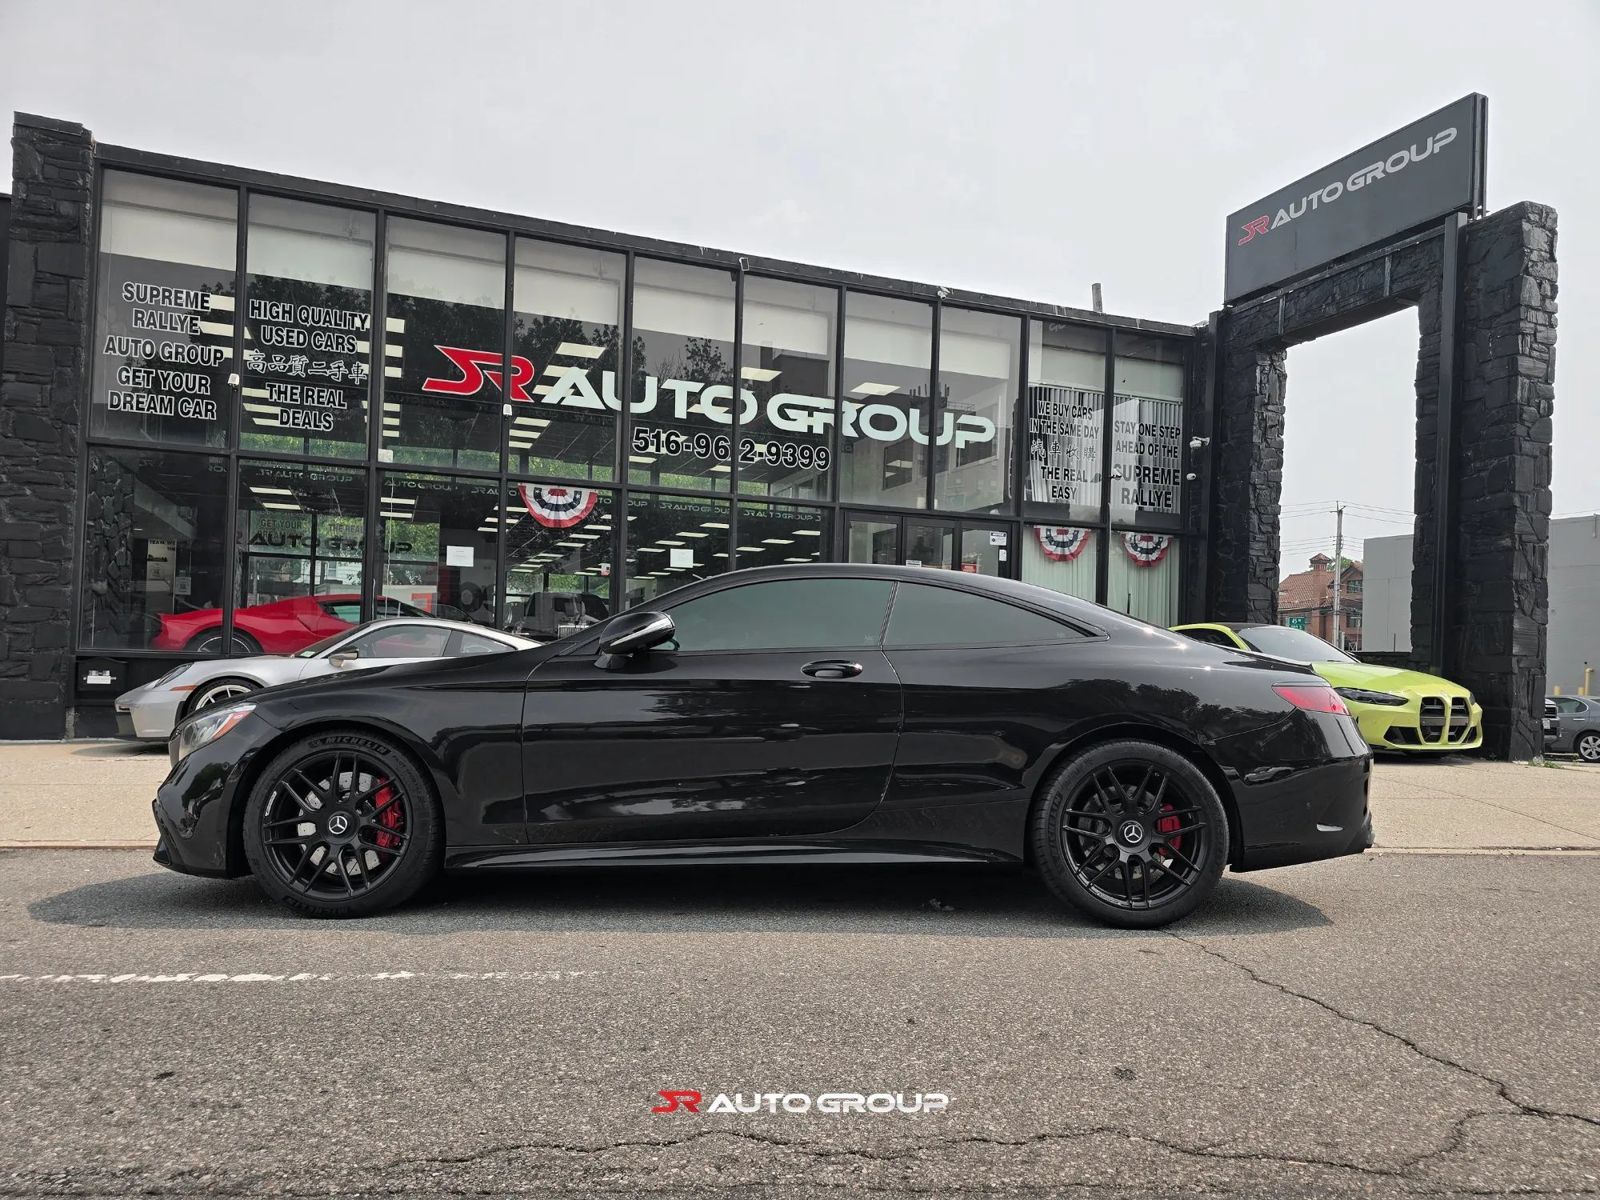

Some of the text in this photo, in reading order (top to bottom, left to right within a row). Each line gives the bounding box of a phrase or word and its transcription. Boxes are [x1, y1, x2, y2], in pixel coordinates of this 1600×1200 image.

[1270, 182, 1343, 230] AUTO
[1346, 127, 1458, 192] GROUP
[122, 281, 211, 312] SUPREME
[132, 307, 201, 336] RALLYE
[249, 298, 371, 332] HIGH QUALITY
[103, 334, 225, 368] AUTO GROUP
[260, 324, 358, 355] USED CARS
[117, 366, 211, 396] GET YOUR
[246, 348, 368, 385] 高品質二手車
[108, 389, 217, 420] DREAM CAR
[265, 382, 348, 410] THE REAL
[540, 366, 758, 425] AUTO
[766, 392, 996, 449] GROUP
[1037, 400, 1093, 421] WE BUY CARS
[279, 407, 334, 432] DEALS
[1029, 417, 1100, 440] IN THE SAME DAY
[1114, 419, 1181, 440] STAY ONE STEP
[632, 426, 831, 471] 516-962-9399
[1115, 440, 1179, 460] AHEAD OF THE
[1040, 465, 1088, 483] THE REAL
[1113, 463, 1181, 486] SUPREME
[1051, 485, 1077, 501] EASY
[1120, 486, 1172, 509] RALLYE
